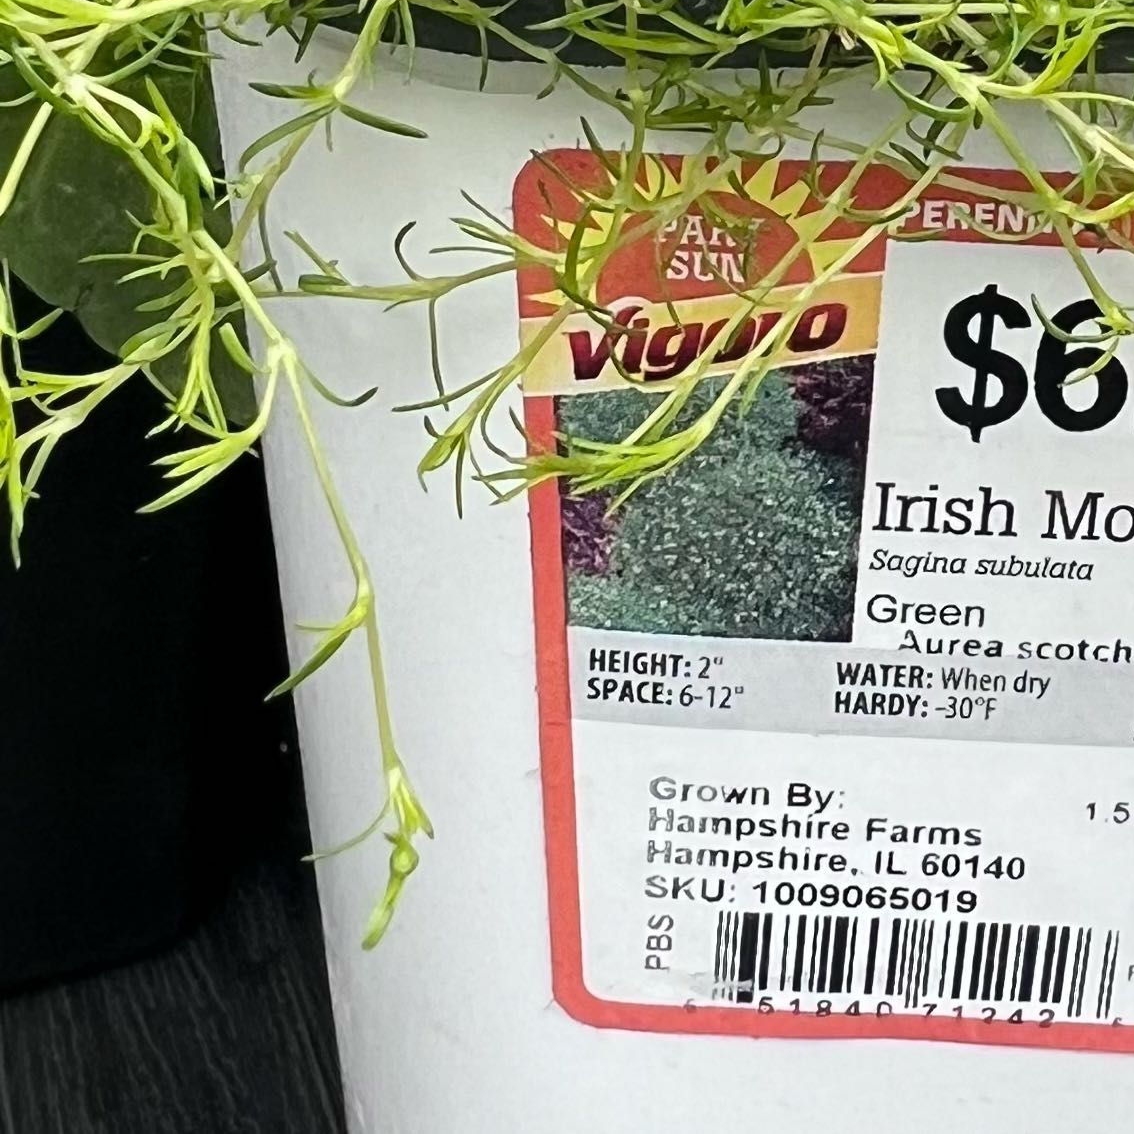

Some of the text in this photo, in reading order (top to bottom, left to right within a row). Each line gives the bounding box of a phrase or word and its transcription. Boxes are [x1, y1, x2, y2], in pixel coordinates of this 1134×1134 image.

[654, 214, 766, 247] PAR
[666, 249, 746, 283] SUN
[872, 482, 1017, 537] Irish
[869, 549, 1094, 580] Sagina subulata
[866, 593, 985, 628] Green
[589, 648, 691, 678] HEIGHT:
[899, 629, 1004, 658] Aurea
[1017, 639, 1132, 664] scotch
[586, 677, 673, 706] SPACE:
[836, 662, 1051, 699] WATER: When dry
[834, 692, 997, 720] HARDY: -30°F
[649, 776, 846, 815] Grown By:
[1086, 802, 1130, 824] 1.5
[648, 807, 983, 847] Hampshire Farms
[646, 840, 1026, 880] Hampshire, IL 60140
[644, 874, 979, 913] SKU: 1009065019
[645, 914, 675, 972] PBS
